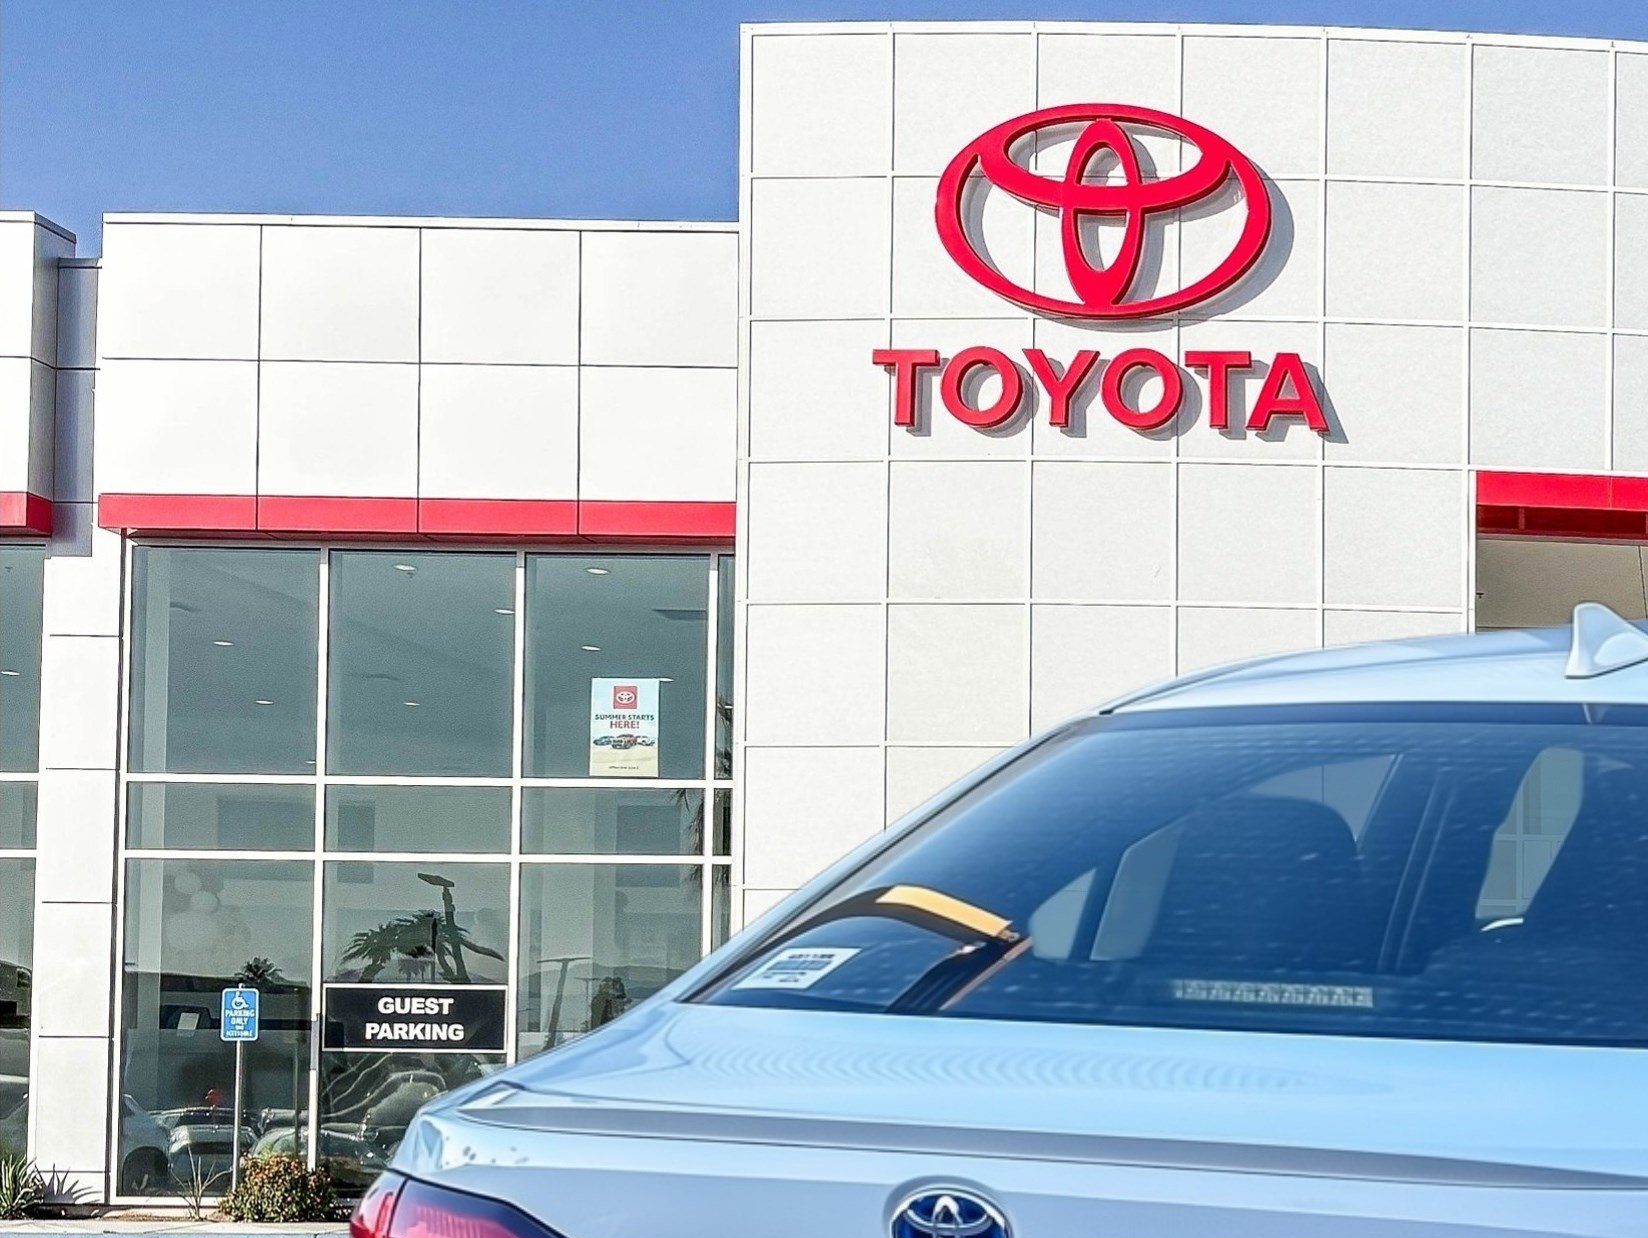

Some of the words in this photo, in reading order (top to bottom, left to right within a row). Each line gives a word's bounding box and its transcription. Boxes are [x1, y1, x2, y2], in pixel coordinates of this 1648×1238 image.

[872, 346, 1329, 432] TOYOTA
[609, 720, 640, 729] HERE!
[377, 996, 455, 1015] GUEST
[365, 1022, 465, 1042] PARKING
